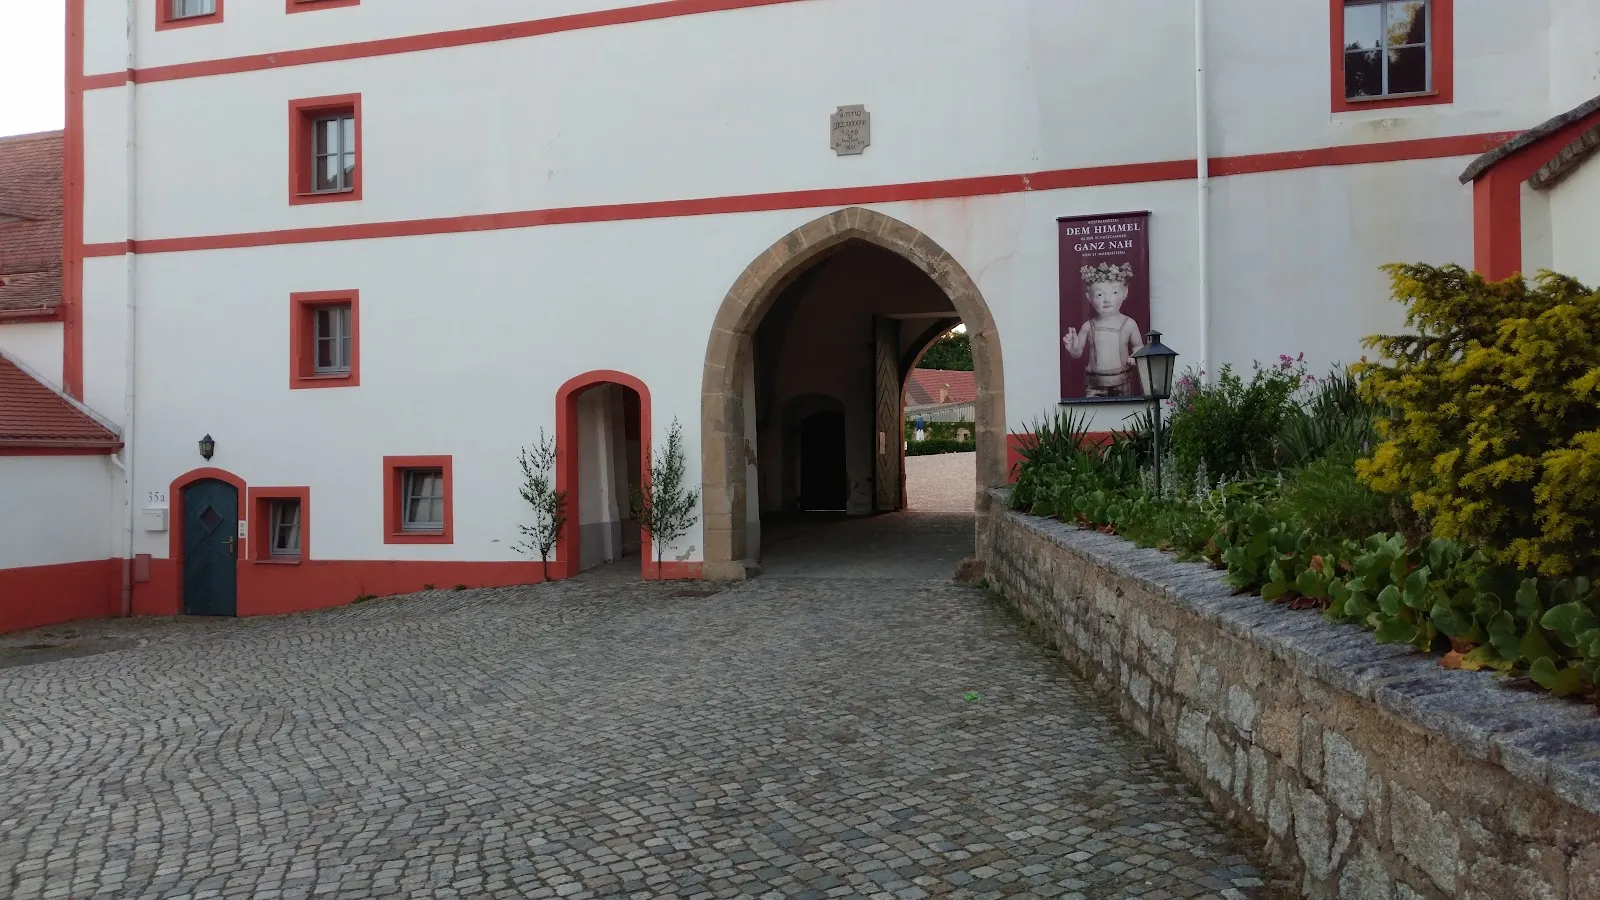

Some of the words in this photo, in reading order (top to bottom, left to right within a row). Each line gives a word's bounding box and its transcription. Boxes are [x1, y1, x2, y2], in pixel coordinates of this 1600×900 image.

[1066, 227, 1090, 236] DEM
[1094, 223, 1140, 234] HIMMEL
[1074, 242, 1106, 252] GANZ
[1108, 239, 1133, 249] NAH
[148, 492, 164, 502] 35a
